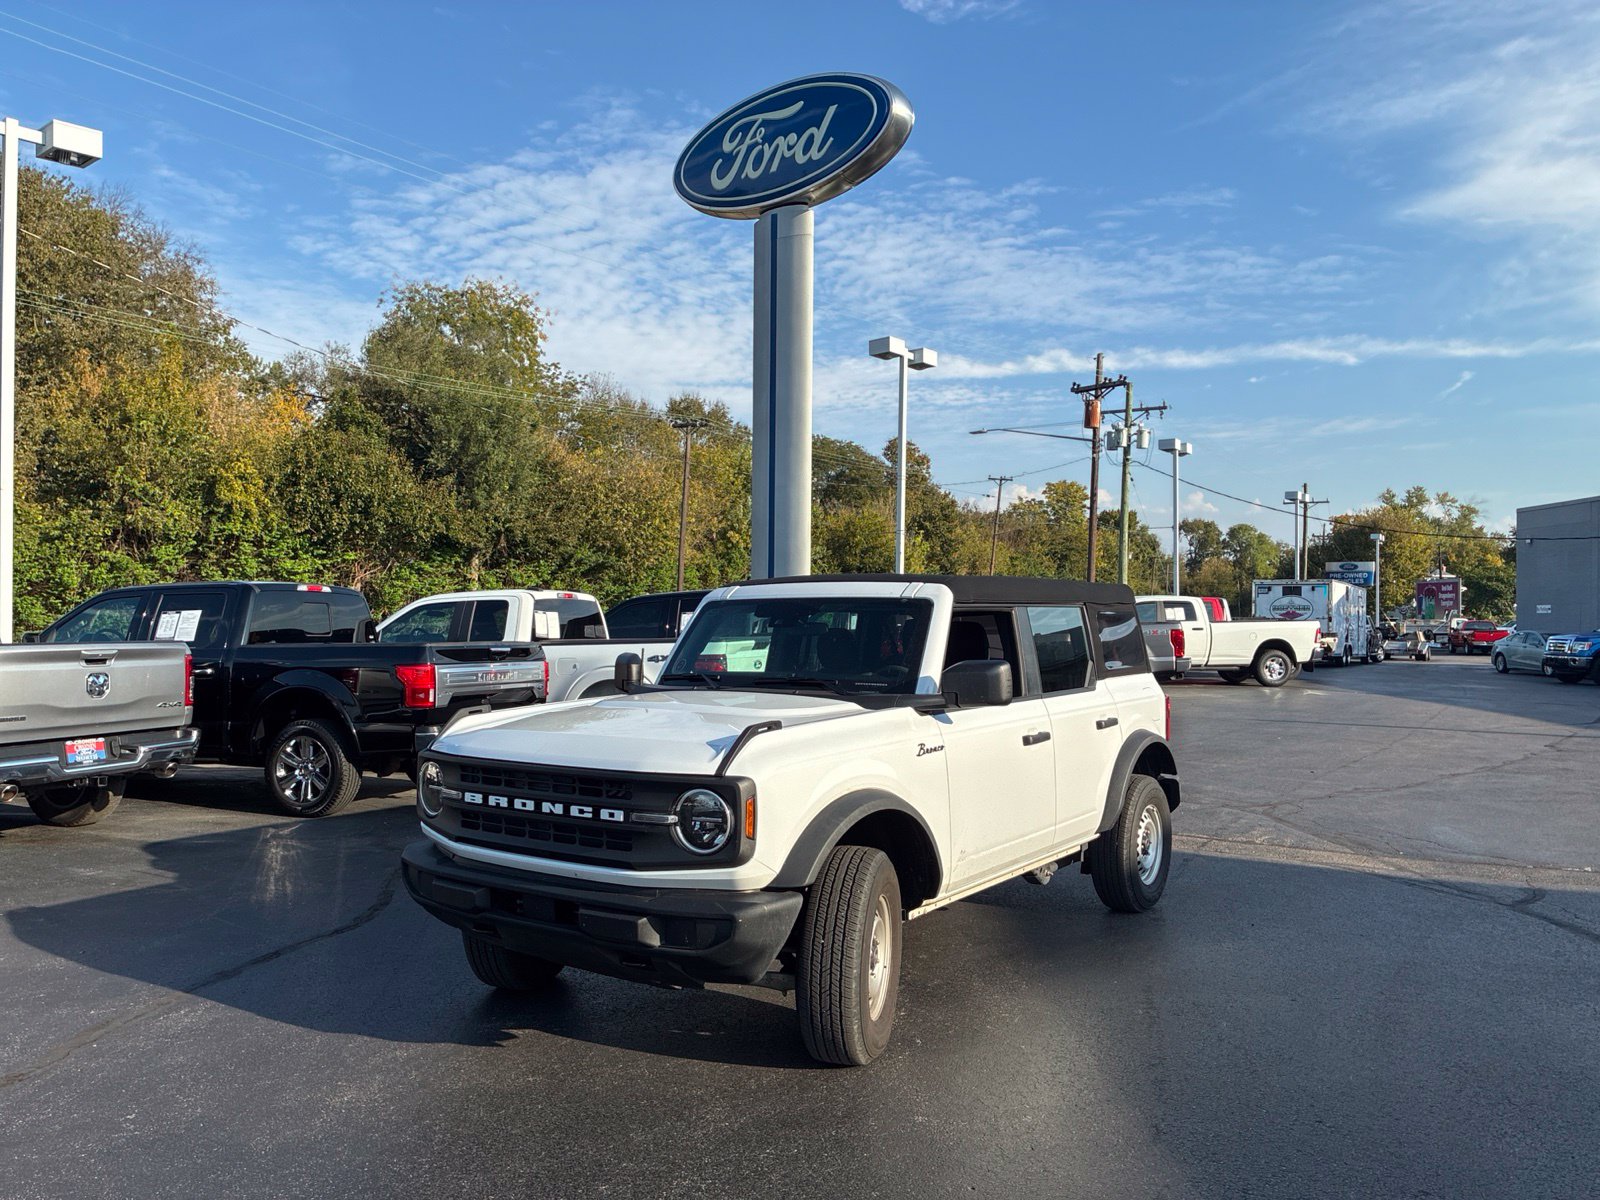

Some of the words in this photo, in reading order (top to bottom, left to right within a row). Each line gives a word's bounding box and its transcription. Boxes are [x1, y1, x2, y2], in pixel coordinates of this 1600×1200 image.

[710, 100, 839, 191] Ford
[478, 672, 495, 682] KING
[916, 742, 945, 757] Bronco
[75, 753, 98, 762] NORTH
[464, 792, 624, 822] BRONCO
